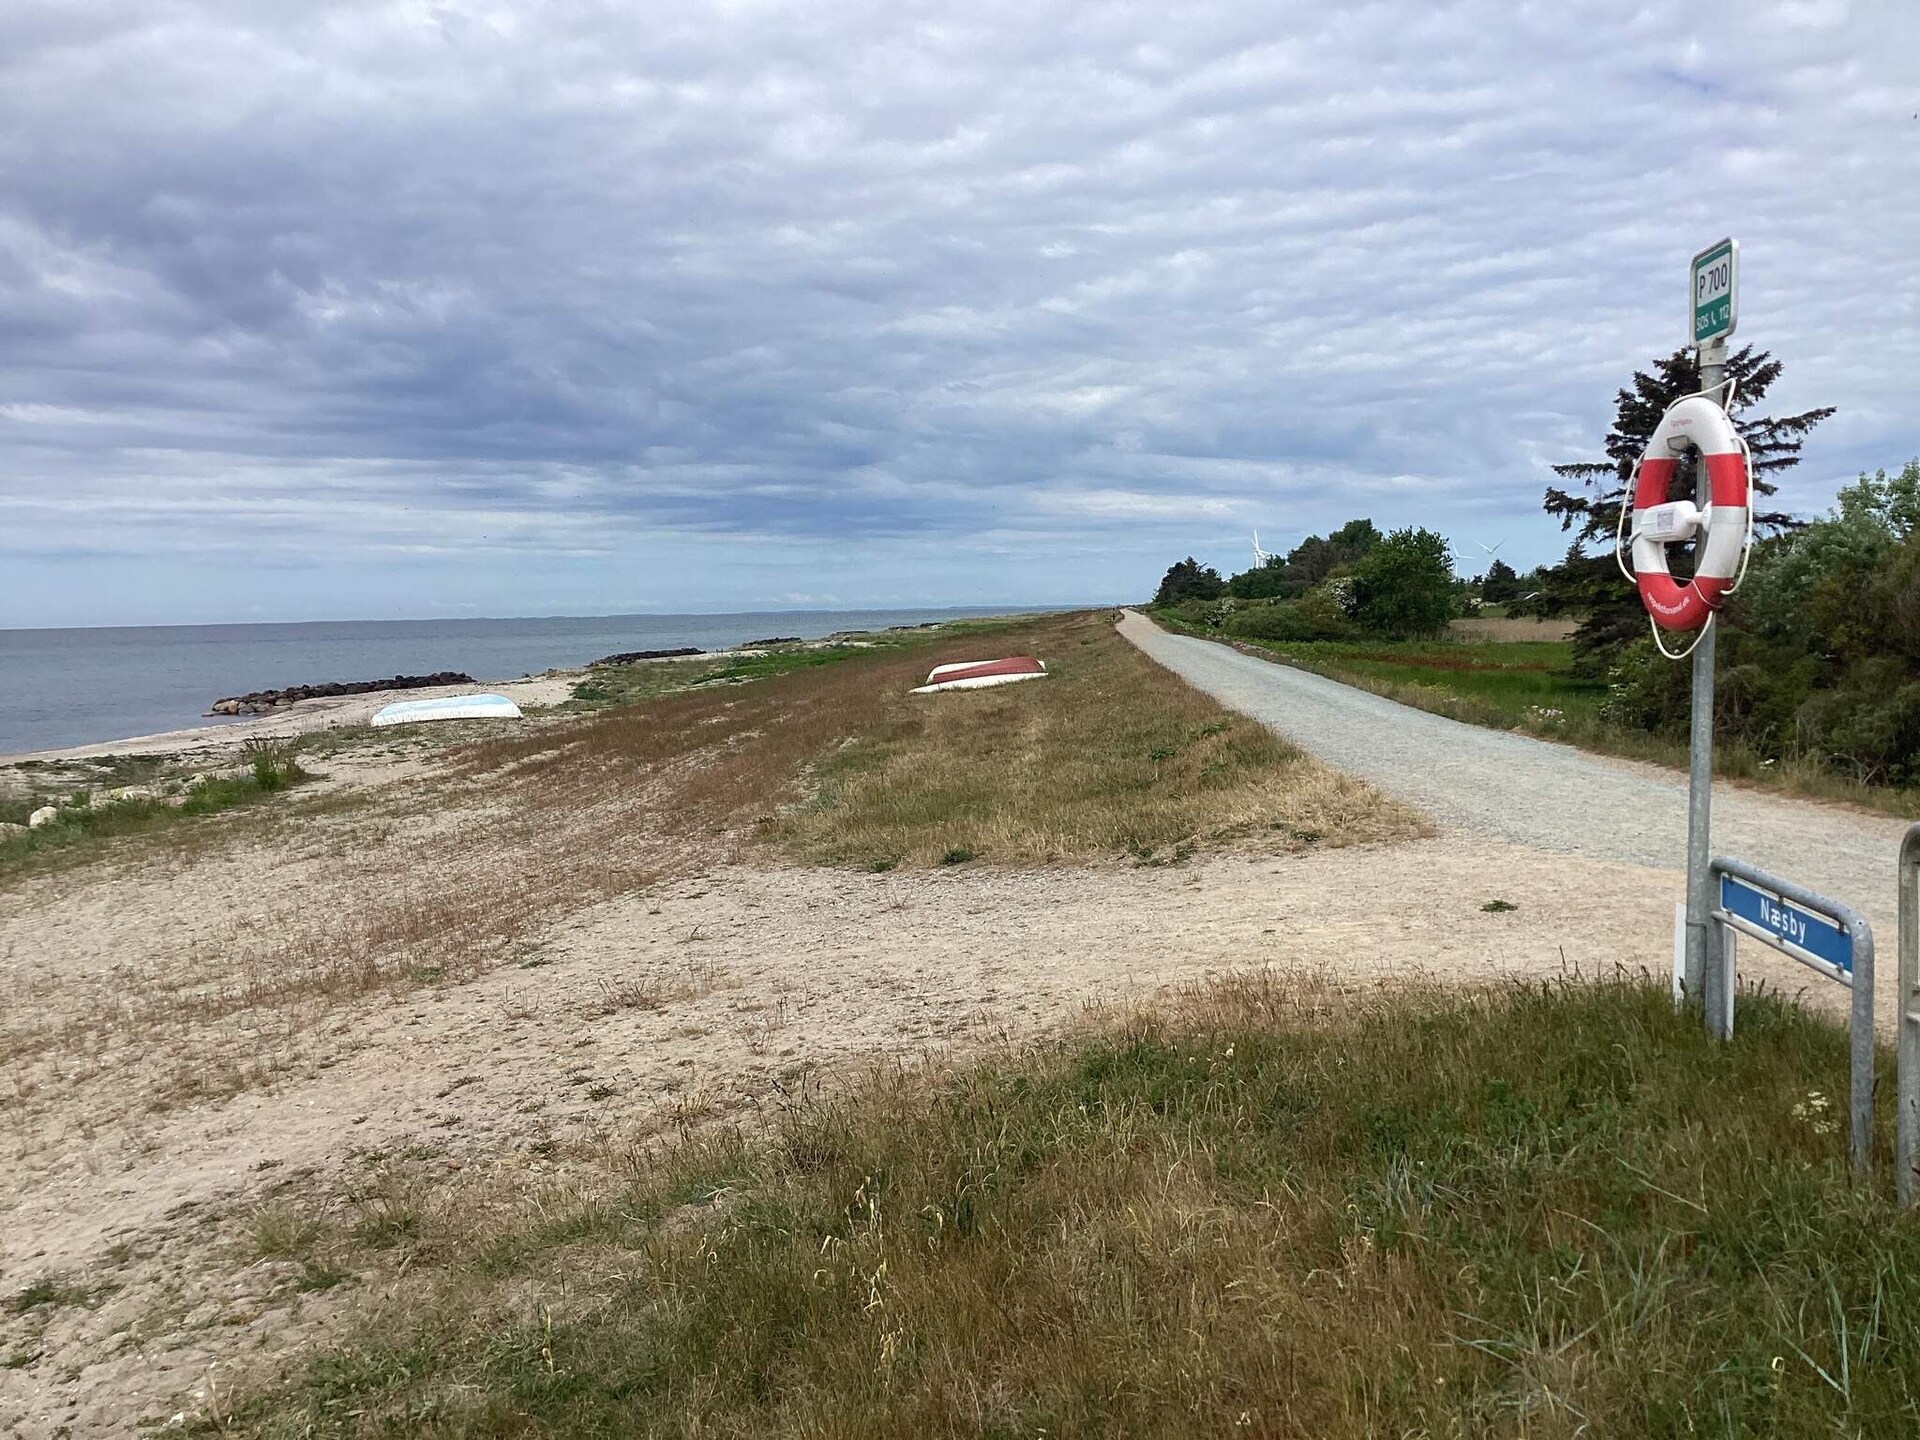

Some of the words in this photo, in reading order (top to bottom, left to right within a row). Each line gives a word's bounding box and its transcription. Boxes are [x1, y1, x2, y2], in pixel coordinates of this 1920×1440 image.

[1699, 275, 1706, 298] P
[1708, 263, 1727, 294] 700
[1696, 313, 1710, 331] SOS
[1761, 898, 1806, 944] Næsby
